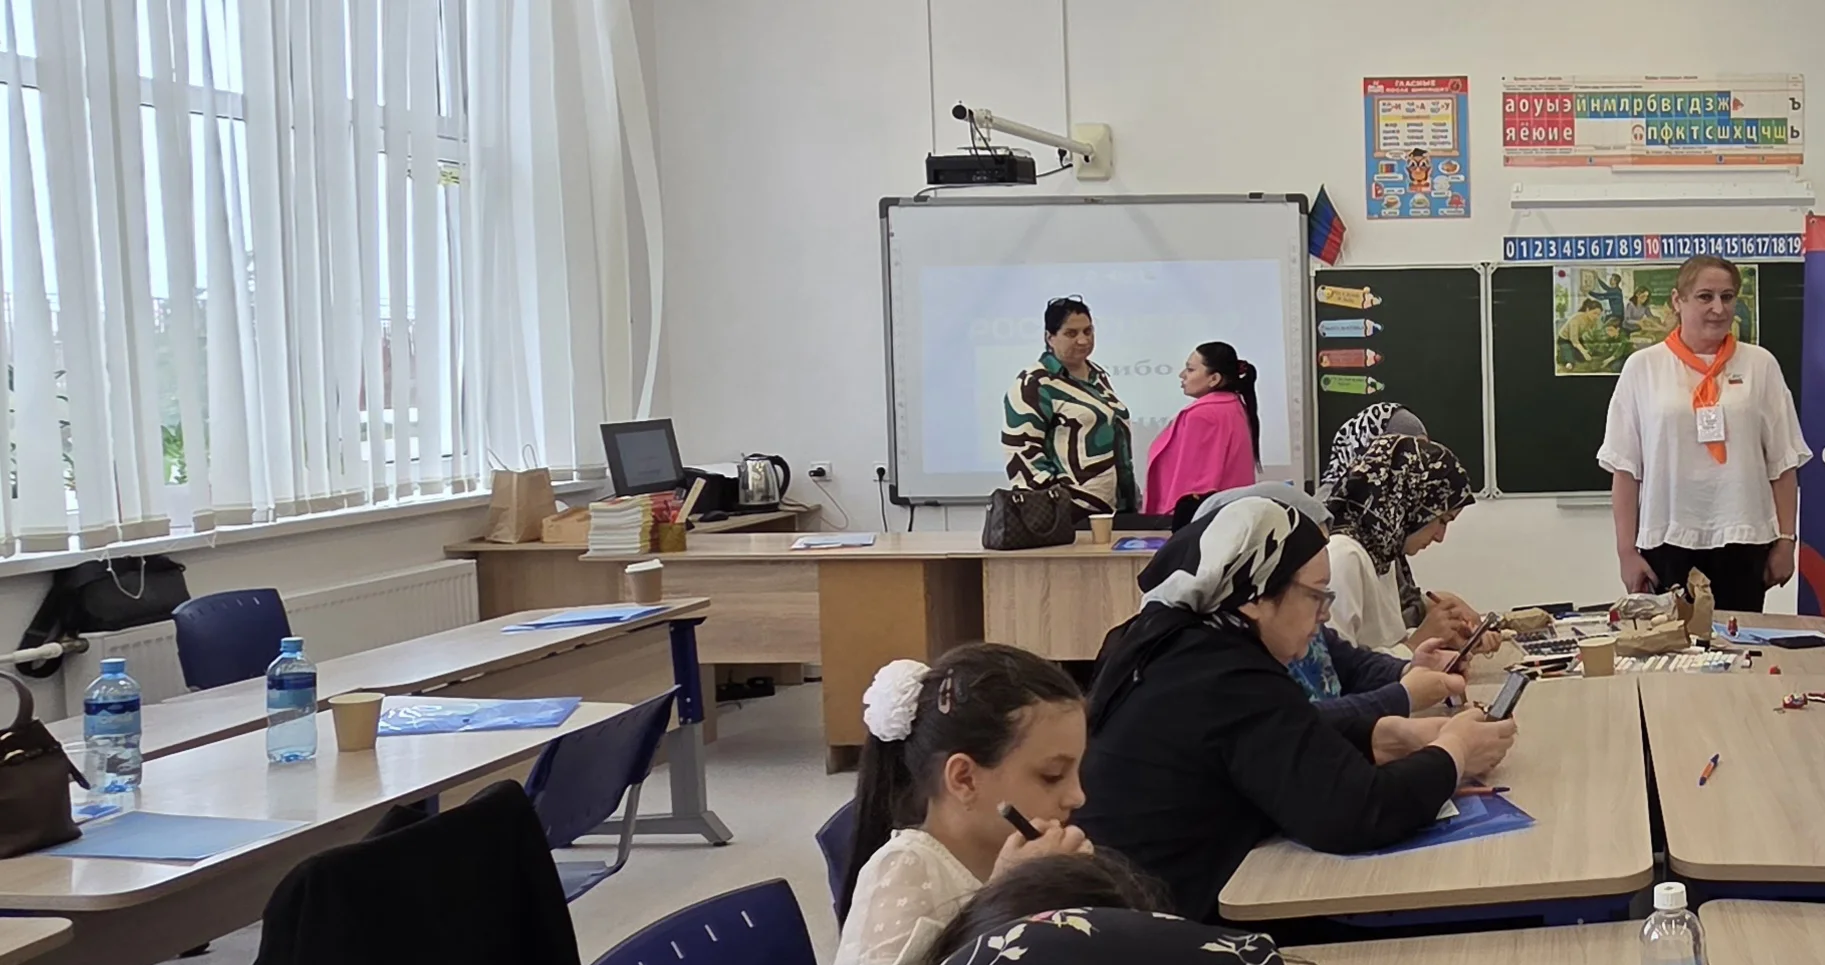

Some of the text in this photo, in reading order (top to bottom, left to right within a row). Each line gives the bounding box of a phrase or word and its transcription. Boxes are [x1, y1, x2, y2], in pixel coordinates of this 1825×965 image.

[1506, 237, 1800, 257] 0 1 2 3 4 5 6 7 8 9 10 11 12 13 14 15 16 17 18 19
